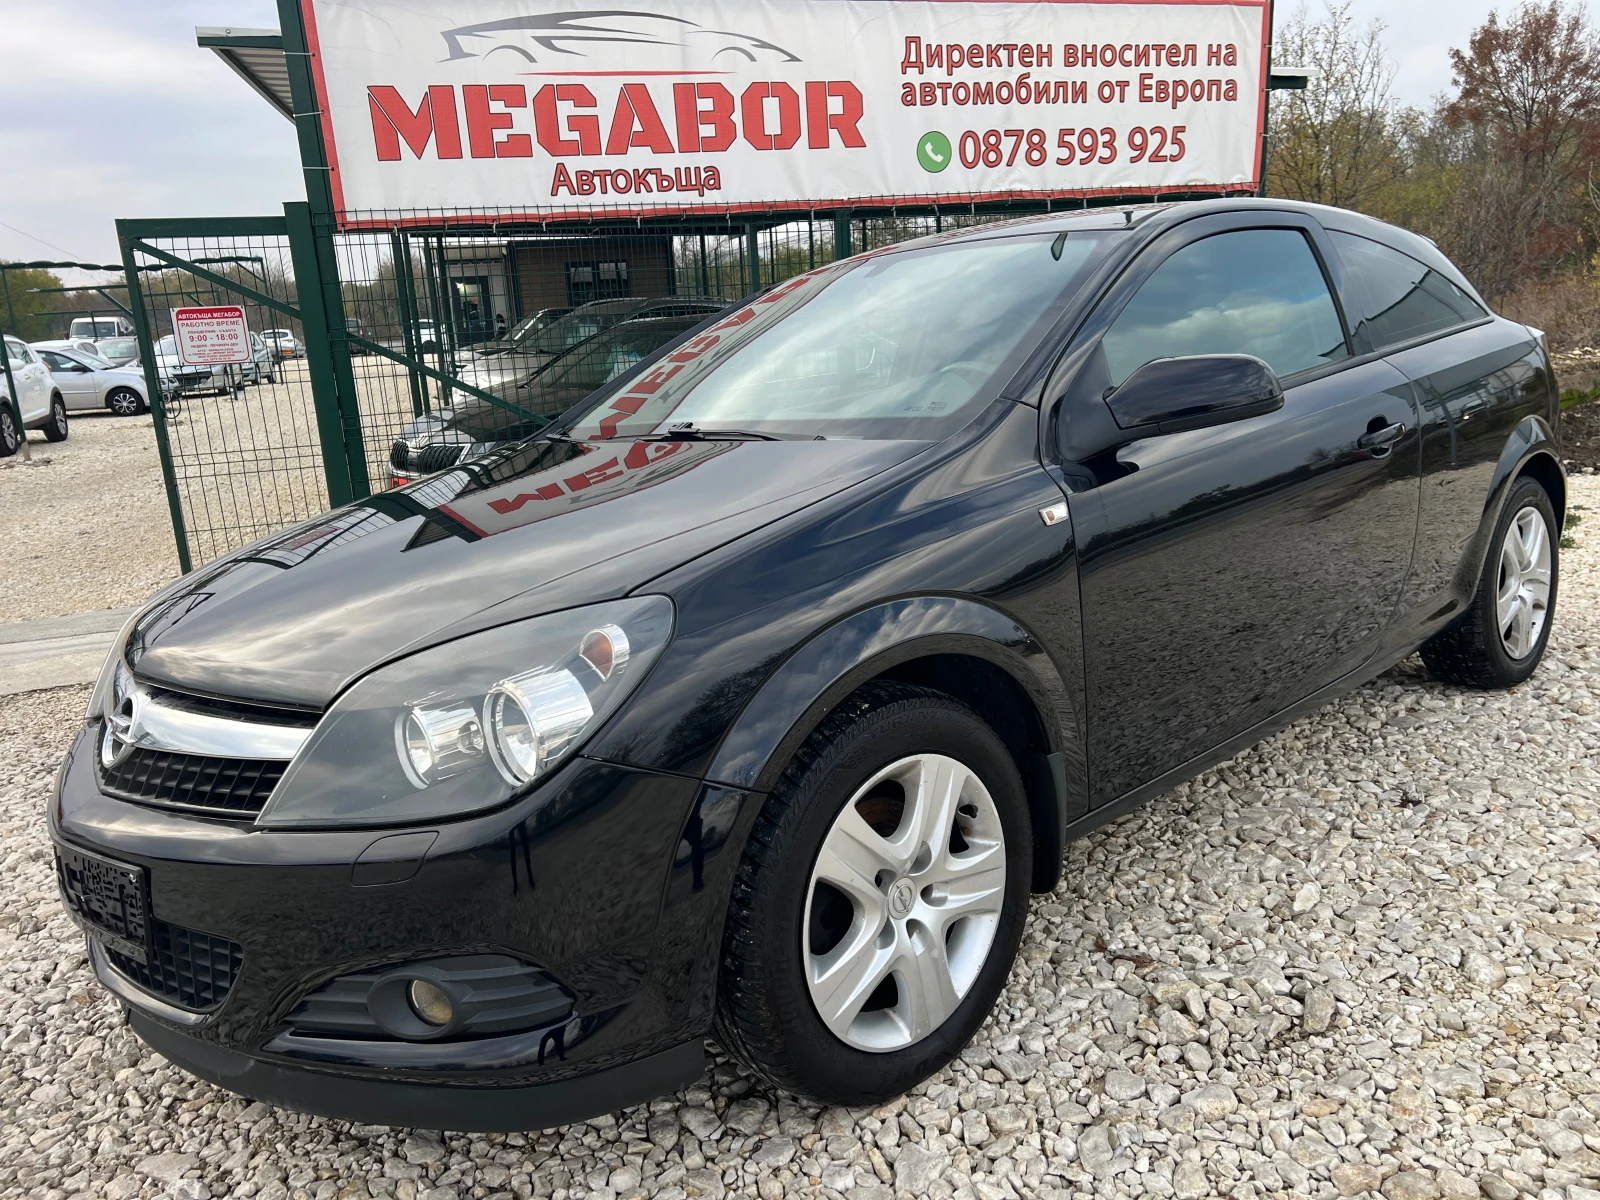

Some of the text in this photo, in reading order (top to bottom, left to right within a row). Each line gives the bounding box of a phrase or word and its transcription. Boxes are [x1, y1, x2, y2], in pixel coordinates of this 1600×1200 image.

[901, 36, 1238, 76] Директен вносител на
[901, 73, 1238, 109] автомобили от Европа
[368, 80, 866, 161] MEGABOR
[958, 125, 1187, 169] 0878 593 925
[550, 162, 722, 197] Автокъща
